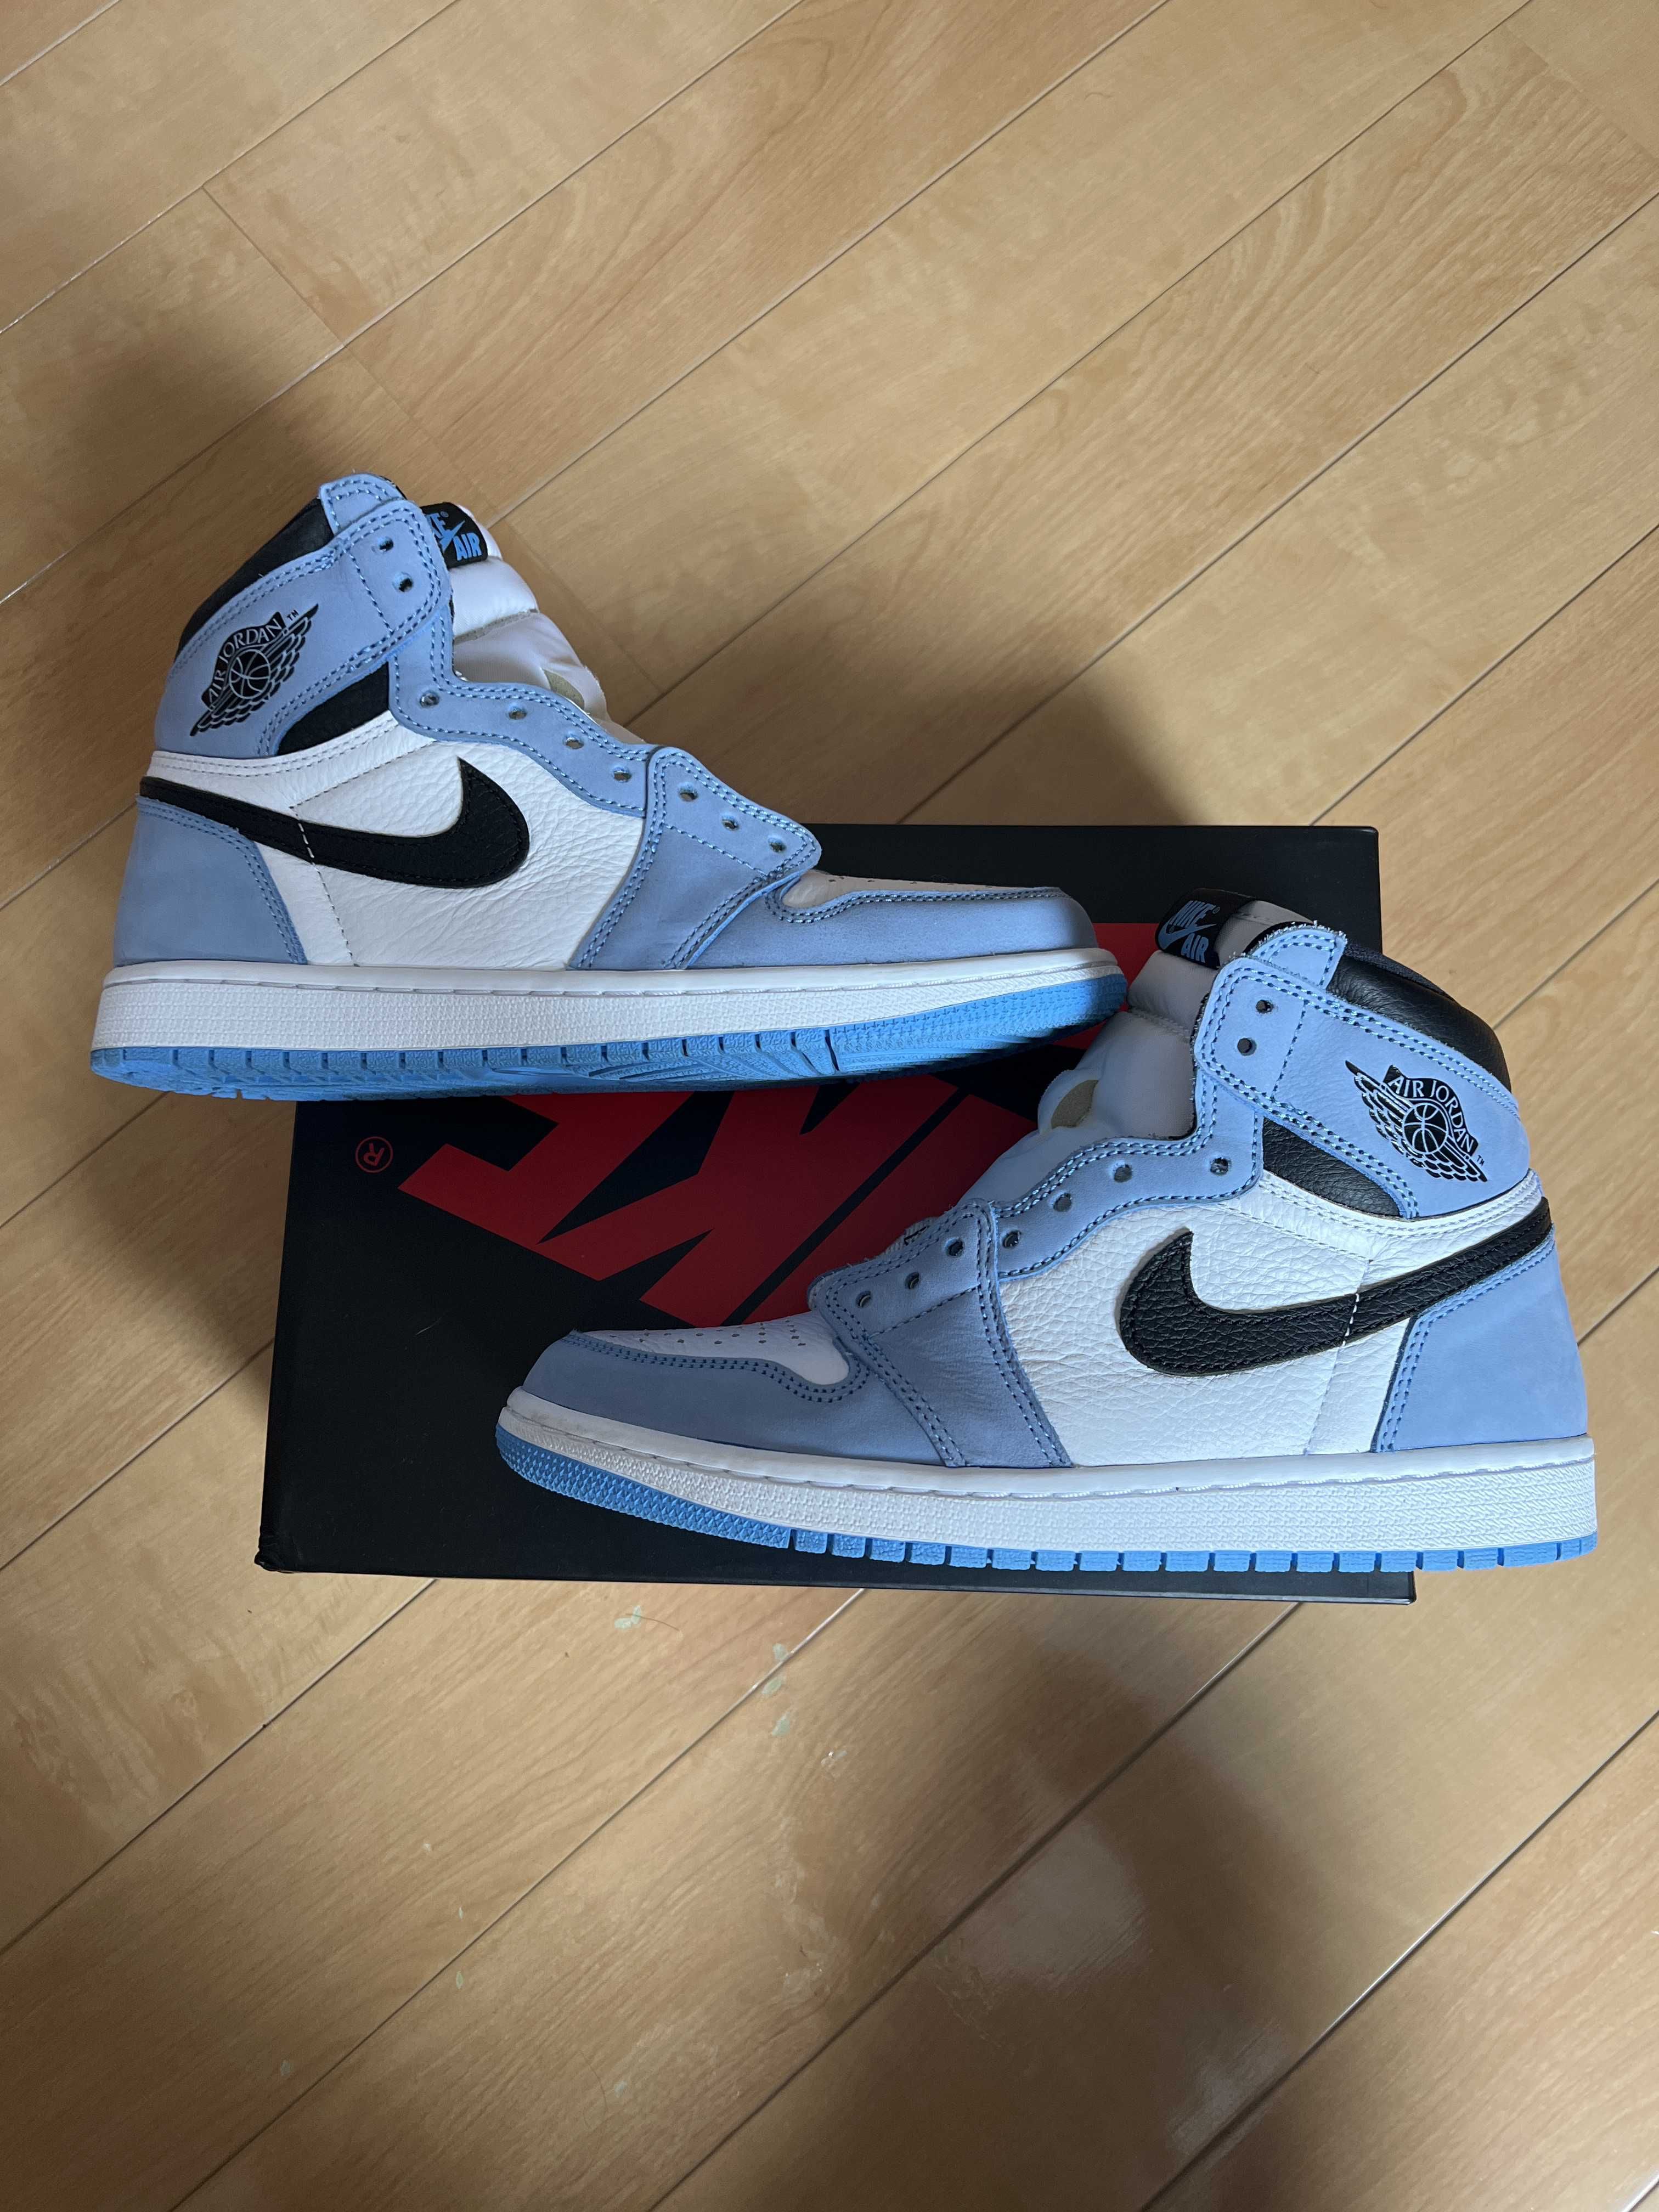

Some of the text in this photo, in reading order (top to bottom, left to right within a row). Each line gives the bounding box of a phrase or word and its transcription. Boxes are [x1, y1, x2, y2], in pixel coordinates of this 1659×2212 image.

[453, 532, 483, 561] AIR
[208, 618, 282, 703] AIR JORDAN
[1170, 900, 1216, 928] NIKE
[1181, 933, 1209, 963] AIR
[1387, 1076, 1475, 1153] AIR JORDAN
